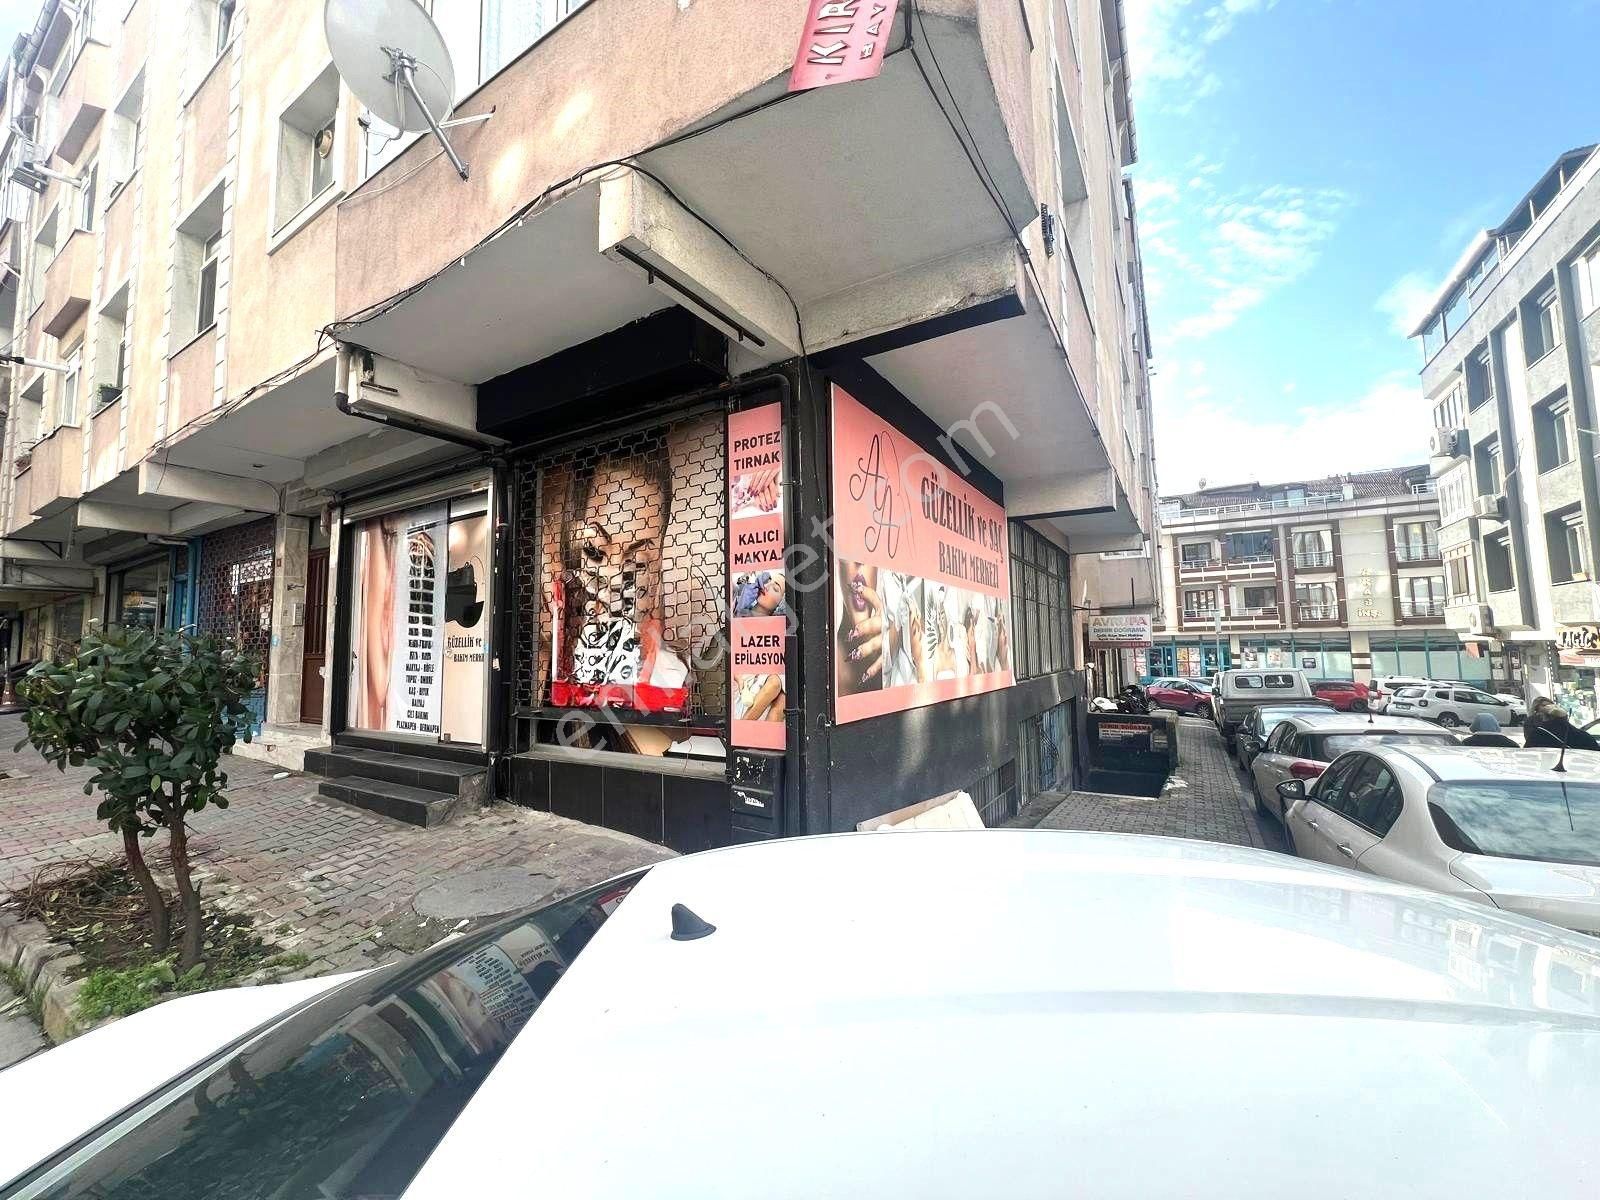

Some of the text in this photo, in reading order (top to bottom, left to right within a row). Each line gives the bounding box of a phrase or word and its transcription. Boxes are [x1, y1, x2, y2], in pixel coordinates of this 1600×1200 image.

[734, 430, 781, 453] PROTEZ
[733, 450, 780, 471] TIRNAK
[920, 471, 975, 542] GÜZELLİK
[738, 529, 779, 546] KALICI
[734, 547, 785, 565] MAKYAJ
[938, 540, 999, 589] BAKIM MERKEZİ
[740, 634, 781, 648] LAZER
[734, 649, 786, 665] EPİLASYON
